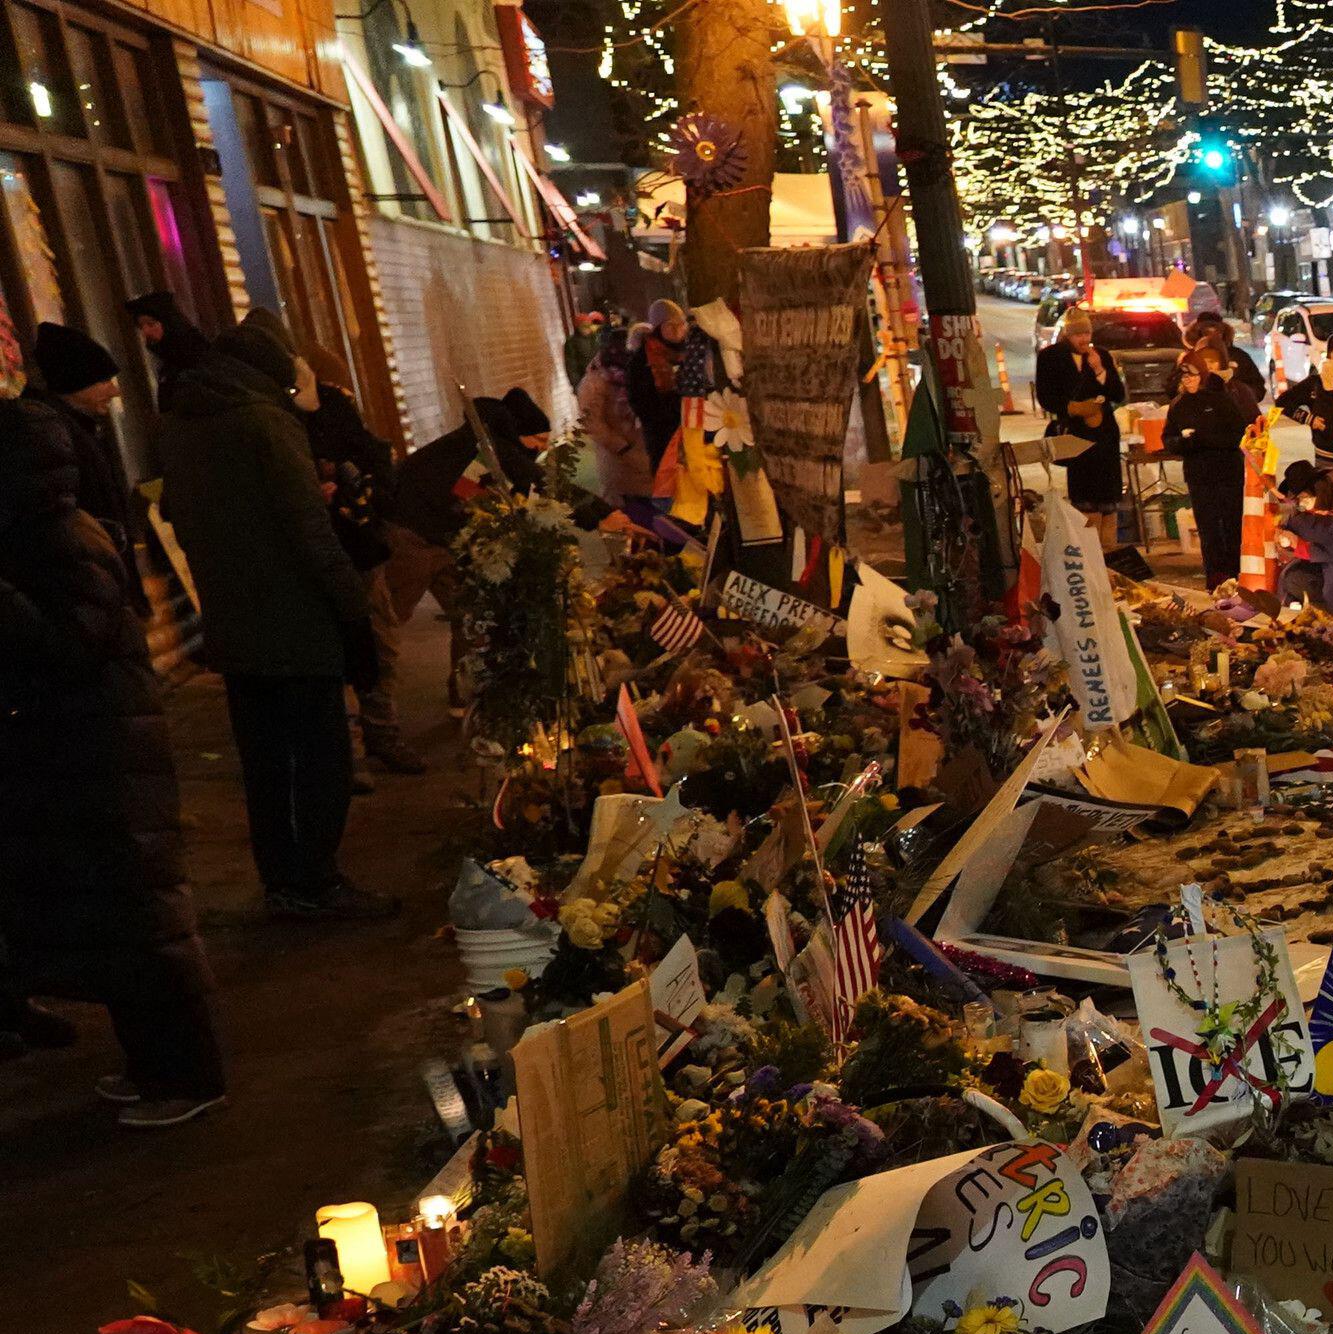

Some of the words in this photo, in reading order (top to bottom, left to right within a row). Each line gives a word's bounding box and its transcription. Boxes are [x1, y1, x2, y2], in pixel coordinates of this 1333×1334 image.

[728, 574, 772, 605] ALEX
[1063, 544, 1096, 629] MURDER
[1149, 1021, 1314, 1110] ICE
[1246, 1232, 1298, 1268] YOU
